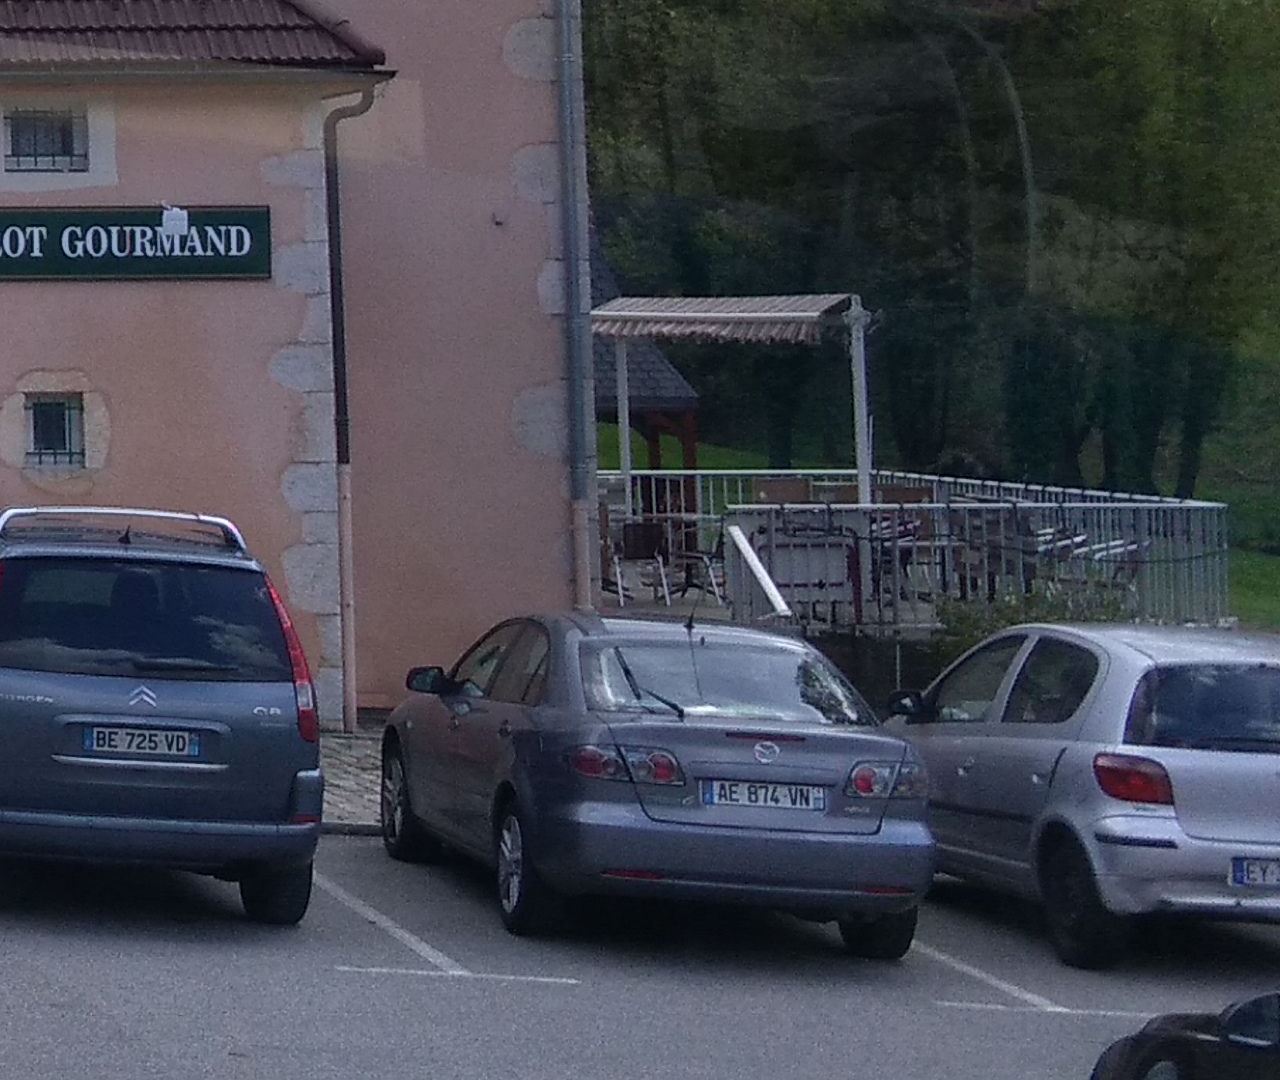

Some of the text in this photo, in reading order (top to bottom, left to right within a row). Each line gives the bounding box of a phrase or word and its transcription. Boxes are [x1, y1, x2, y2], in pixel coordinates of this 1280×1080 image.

[60, 225, 252, 258] GOURMAND
[95, 730, 187, 753] BE 725 VD
[718, 782, 811, 807] AE 874 VN
